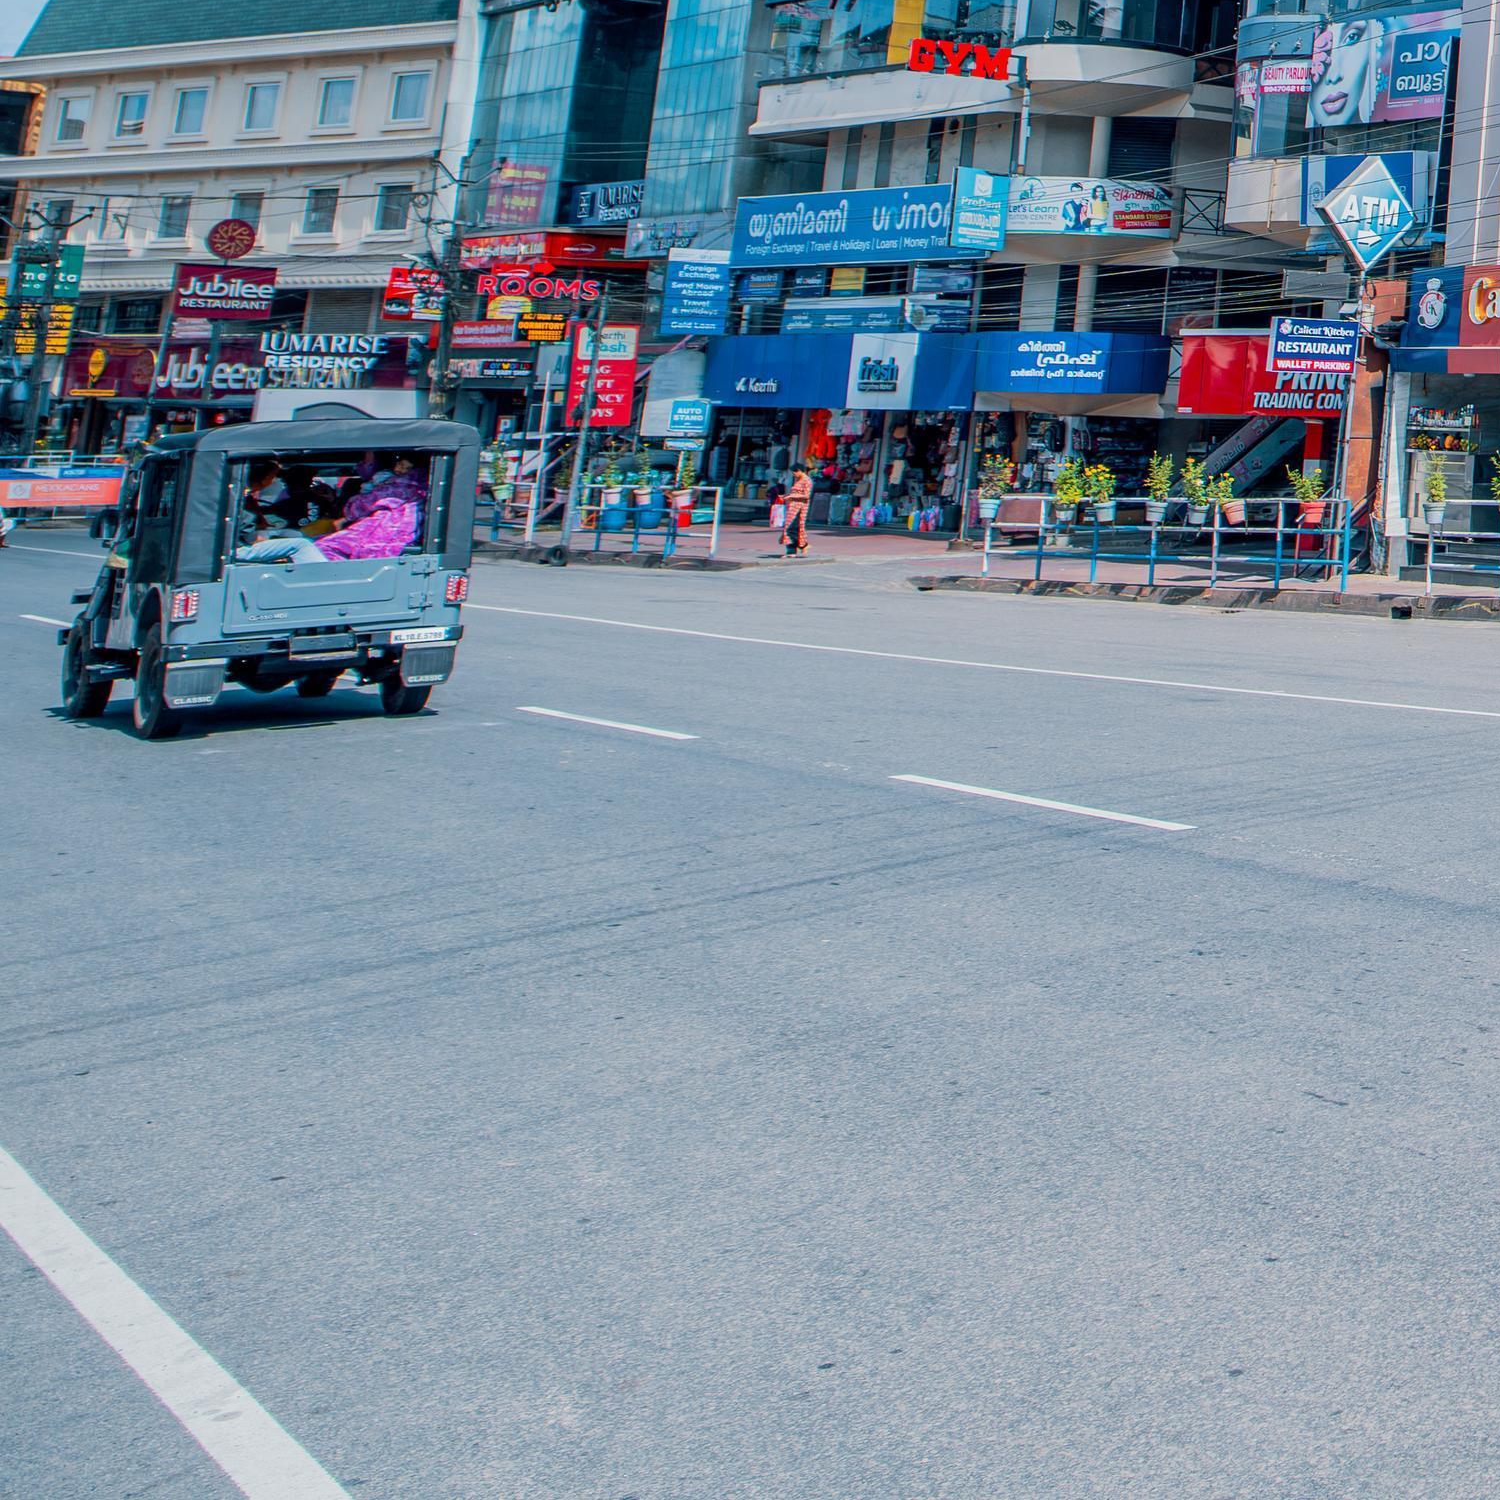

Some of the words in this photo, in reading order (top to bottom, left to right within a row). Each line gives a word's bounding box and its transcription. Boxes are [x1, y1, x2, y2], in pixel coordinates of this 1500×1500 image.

[908, 37, 1012, 81] GYM
[1264, 68, 1285, 81] BEAUTY
[1029, 204, 1059, 213] Learn
[1341, 194, 1400, 227] ATM
[749, 199, 848, 243] യുണിമണി
[772, 243, 804, 254] Exchange
[810, 241, 832, 252] Travel
[840, 240, 870, 252] Holidays
[876, 238, 898, 249] Loans
[904, 237, 928, 250] Money
[678, 271, 721, 280] Exchange
[683, 264, 717, 273] Foreign
[178, 274, 275, 299] Jubilee
[476, 274, 600, 300] ROOMS
[681, 288, 714, 297] Abroad
[695, 282, 724, 291] Money
[179, 298, 269, 311] RESTAURANT
[1293, 325, 1321, 335] Calicut
[1323, 326, 1354, 337] Kitchen
[260, 330, 389, 356] LUMARISE
[1277, 341, 1352, 356] RESTAURANT
[156, 348, 246, 391] Jubiee
[265, 356, 376, 370] RESIDENCY
[859, 356, 899, 382] fresh
[1277, 360, 1312, 369] WALLET
[1314, 361, 1350, 371] PARKING
[748, 377, 778, 393] Keerthi
[1253, 392, 1314, 409] TRADING
[673, 414, 704, 422] STAND
[677, 407, 702, 415] AUTO
[173, 696, 213, 706] CLASSIC
